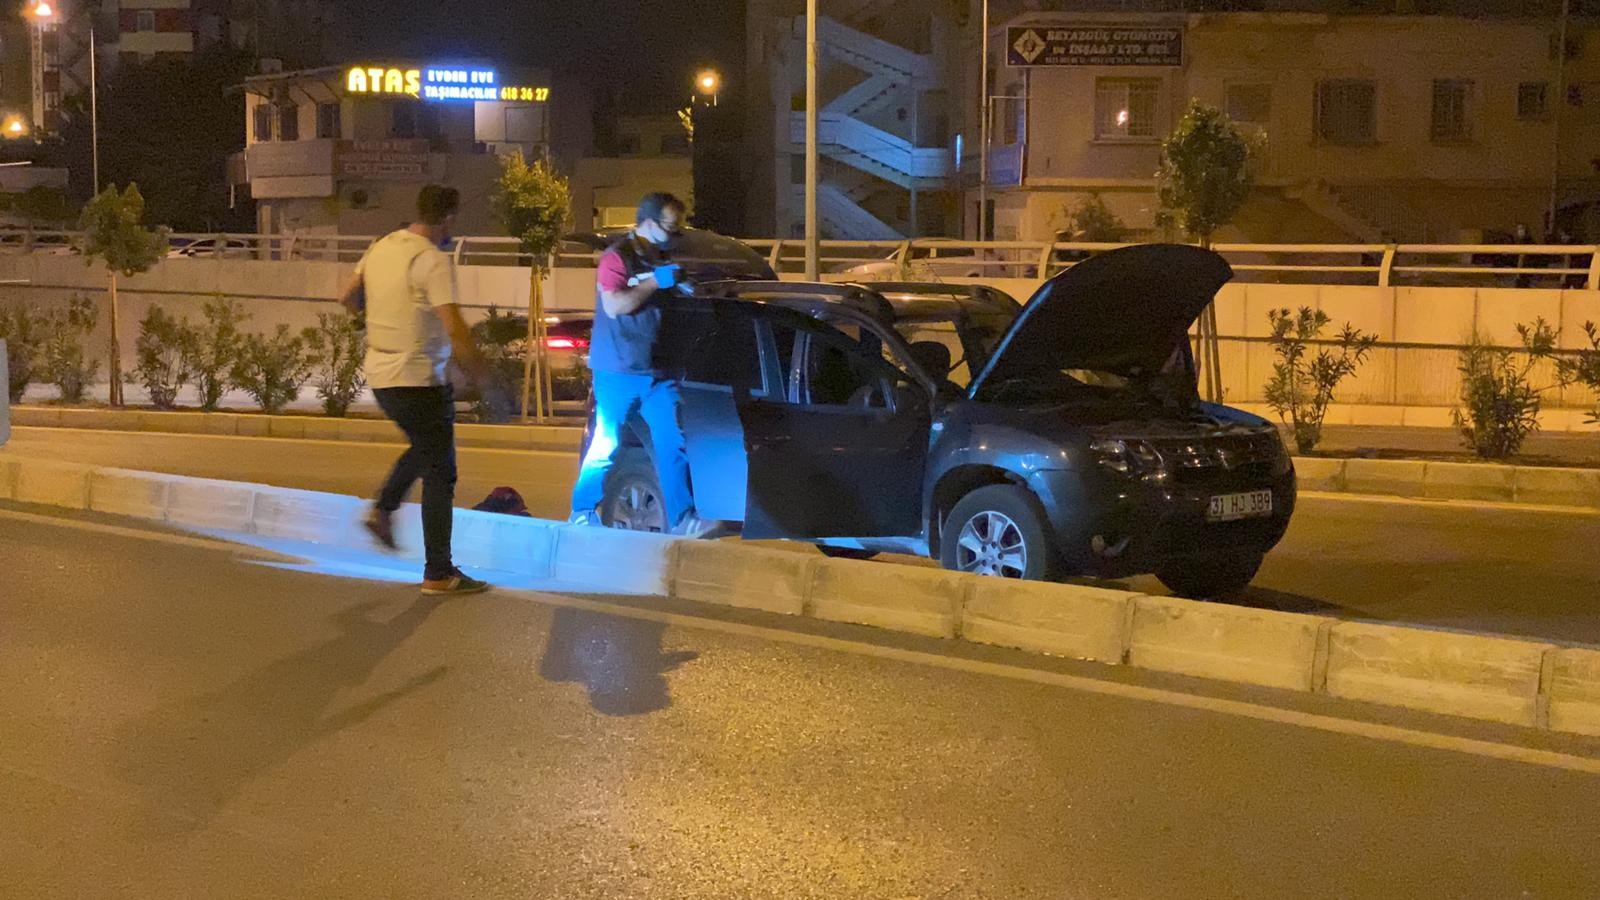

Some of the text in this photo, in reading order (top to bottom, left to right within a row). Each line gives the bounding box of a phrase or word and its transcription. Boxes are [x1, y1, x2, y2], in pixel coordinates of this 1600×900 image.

[500, 86, 518, 100] 618
[520, 87, 533, 100] 36
[535, 88, 549, 101] 27
[1212, 492, 1270, 515] 31 HJ 389
